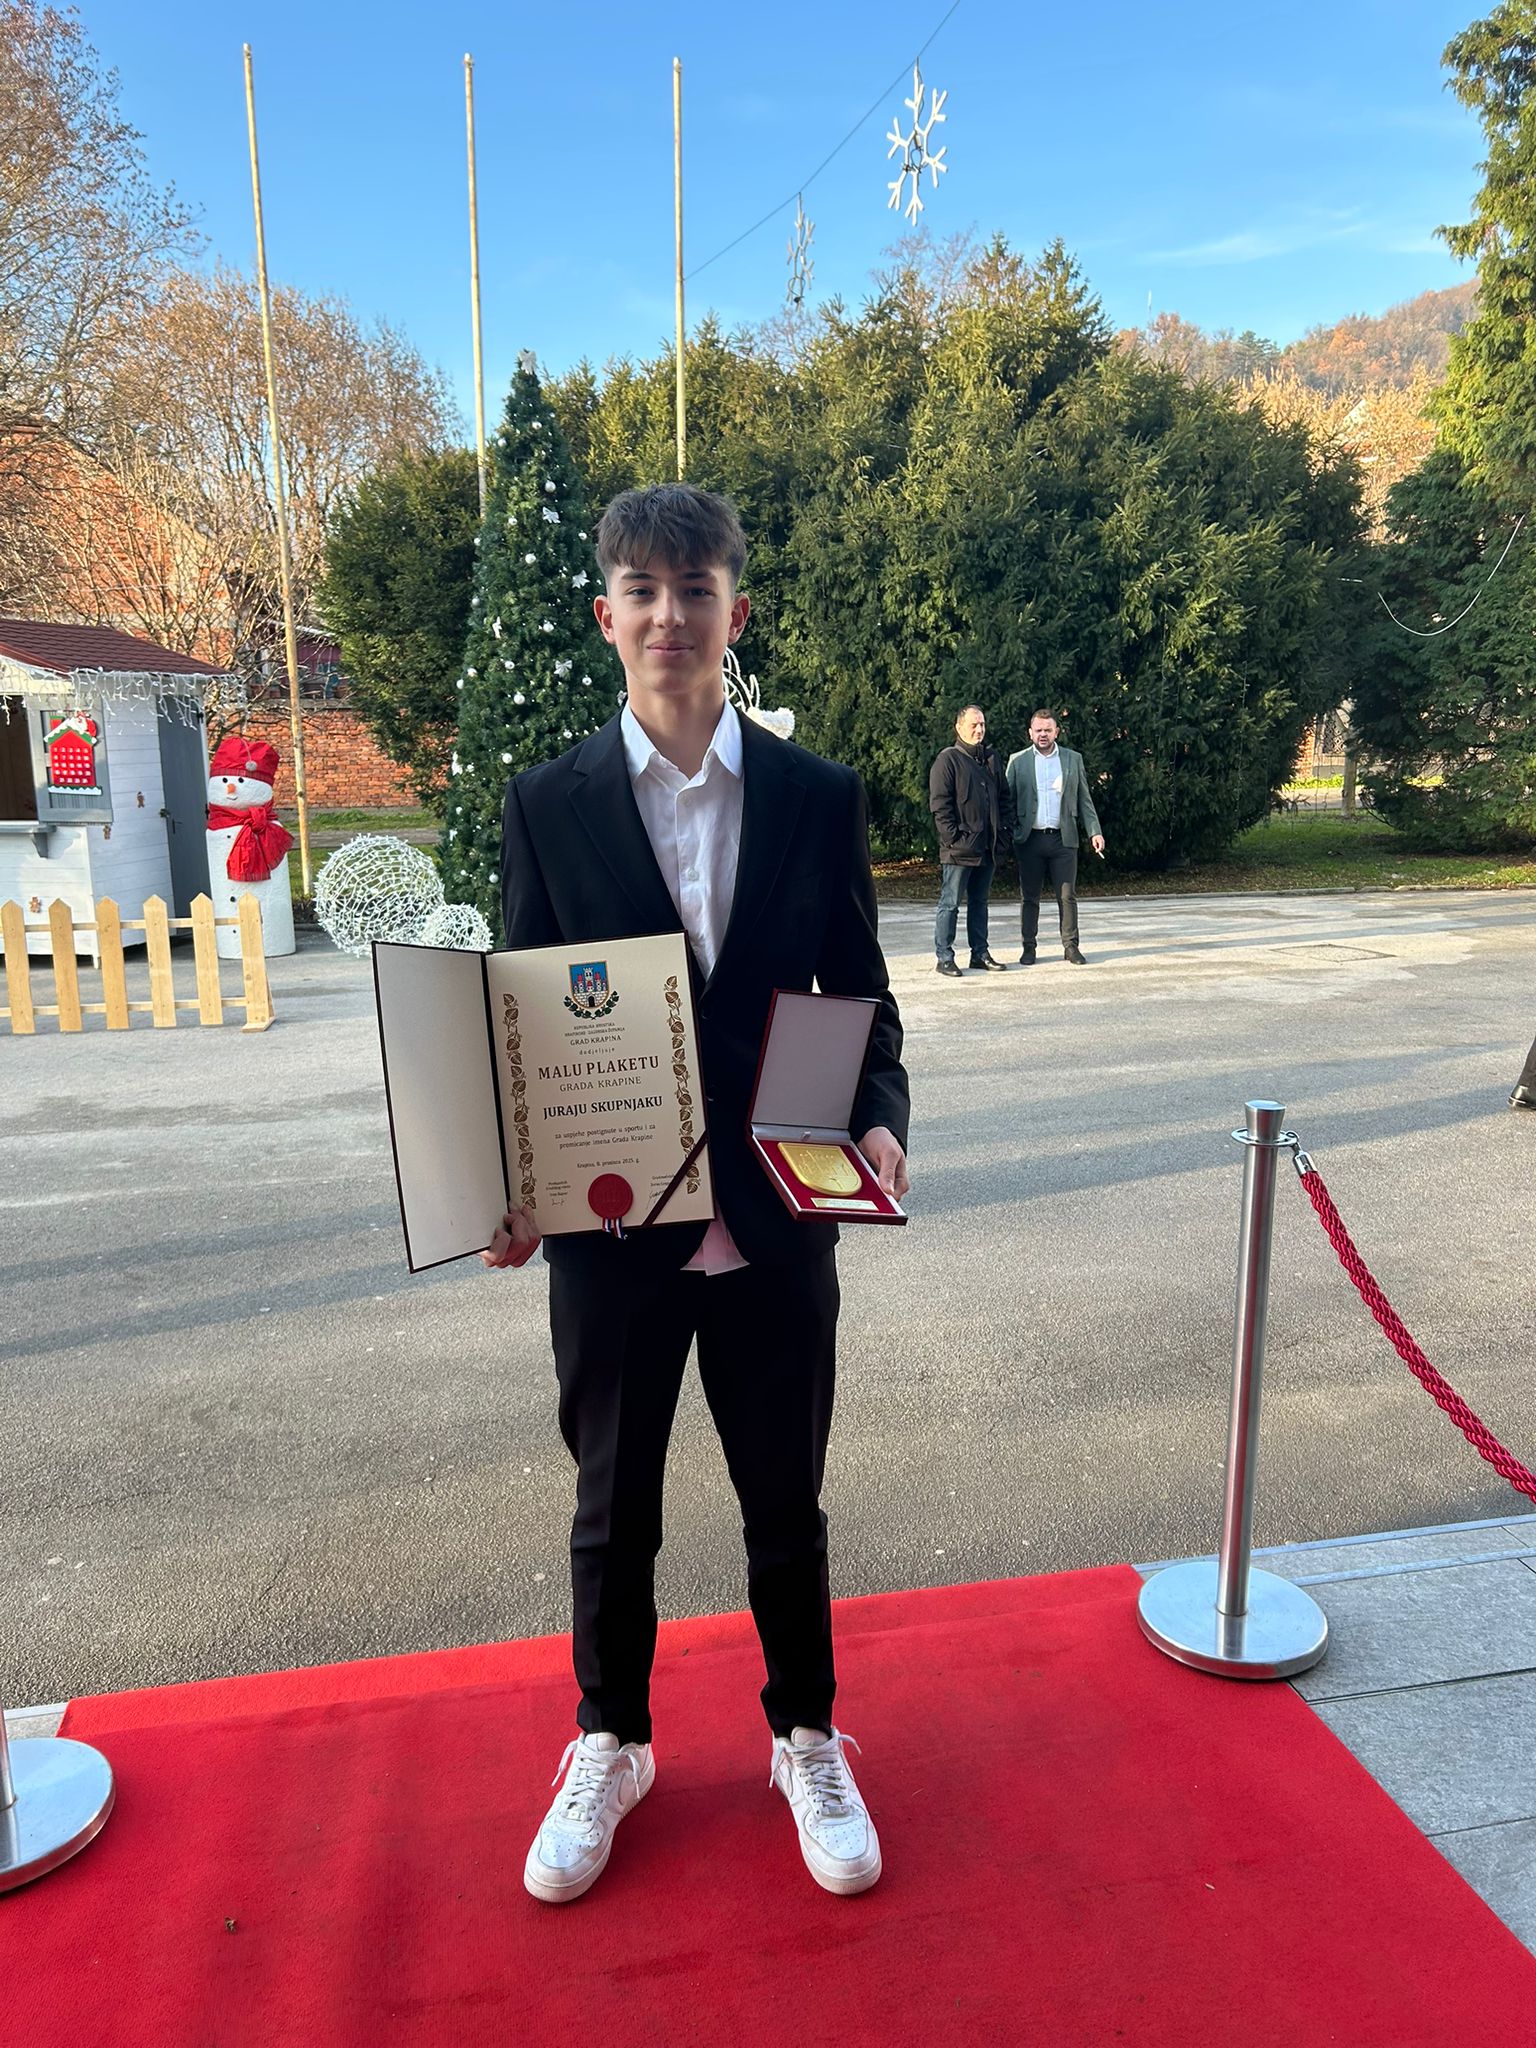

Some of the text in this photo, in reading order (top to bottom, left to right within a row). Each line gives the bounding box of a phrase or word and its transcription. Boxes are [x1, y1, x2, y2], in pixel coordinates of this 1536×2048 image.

[570, 1035, 622, 1046] GRAD KRAPINA
[538, 1055, 660, 1080] MALU PLAKETU
[559, 1076, 642, 1092] GRADA KRAPINE
[543, 1096, 663, 1120] JURAJU SKUPNJAKU
[624, 1125, 643, 1133] sportu
[630, 1134, 653, 1142] Krapine
